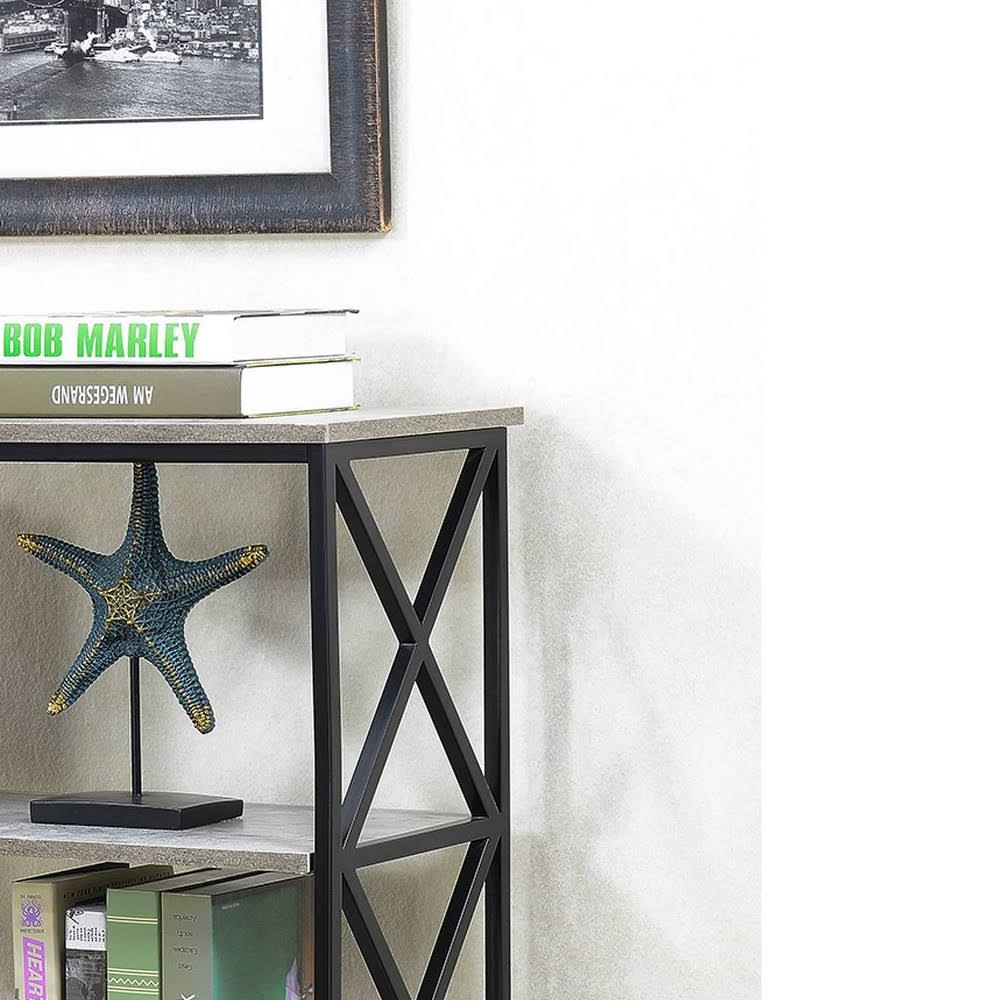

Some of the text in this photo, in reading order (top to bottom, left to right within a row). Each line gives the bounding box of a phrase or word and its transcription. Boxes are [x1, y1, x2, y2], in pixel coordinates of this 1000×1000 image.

[3, 323, 200, 358] BOB MARLEY
[52, 385, 154, 405] AM WEGESRAND
